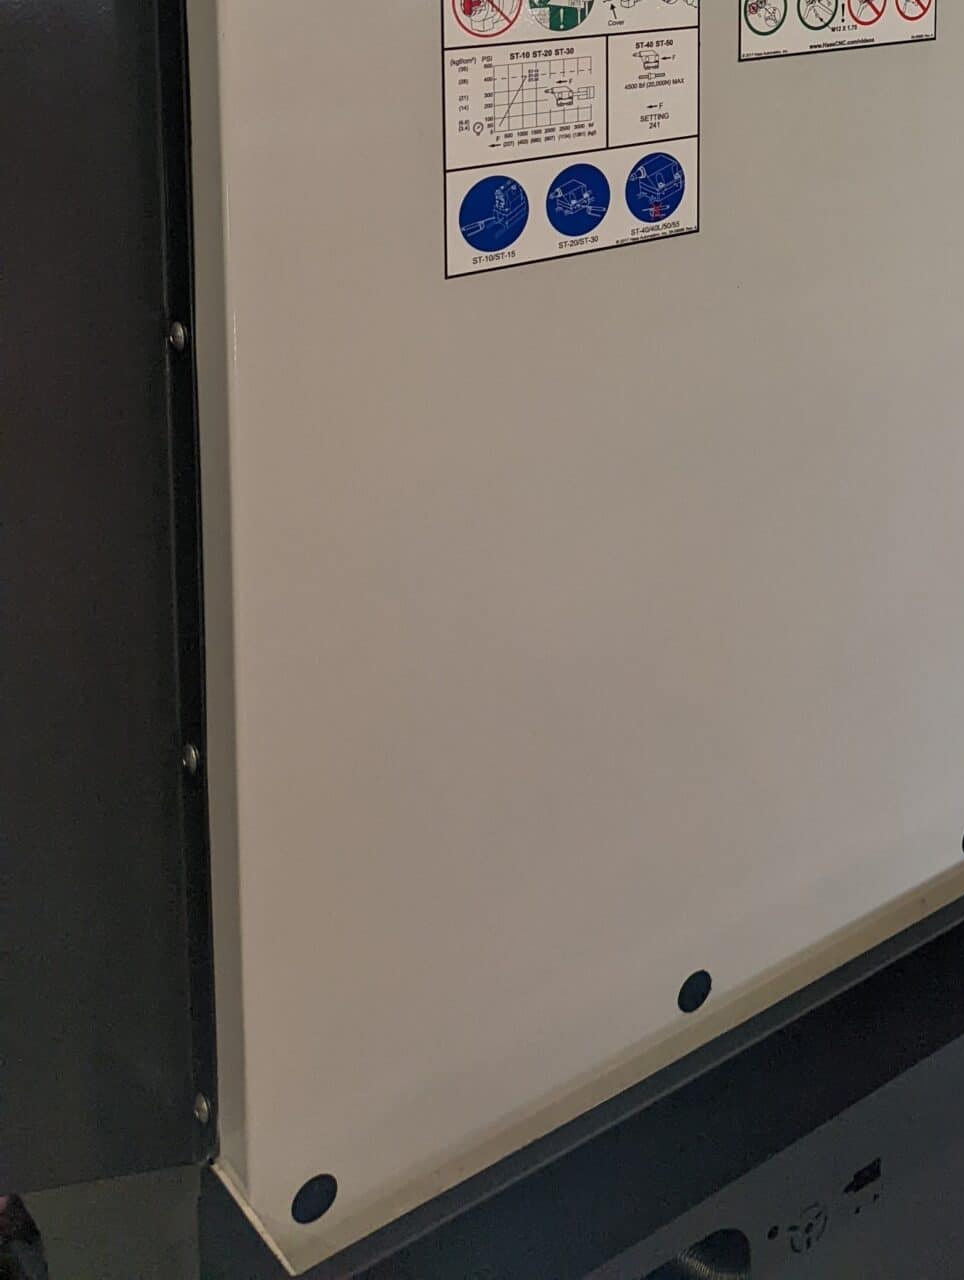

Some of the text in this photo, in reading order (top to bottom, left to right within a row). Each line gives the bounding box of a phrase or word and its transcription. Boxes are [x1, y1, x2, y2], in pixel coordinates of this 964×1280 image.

[510, 47, 575, 61] ST-10 ST-20 ST-30
[640, 112, 670, 122] SETTING
[557, 235, 599, 249] ST-20/ST-30
[472, 250, 516, 265] ST-10/ST-15
